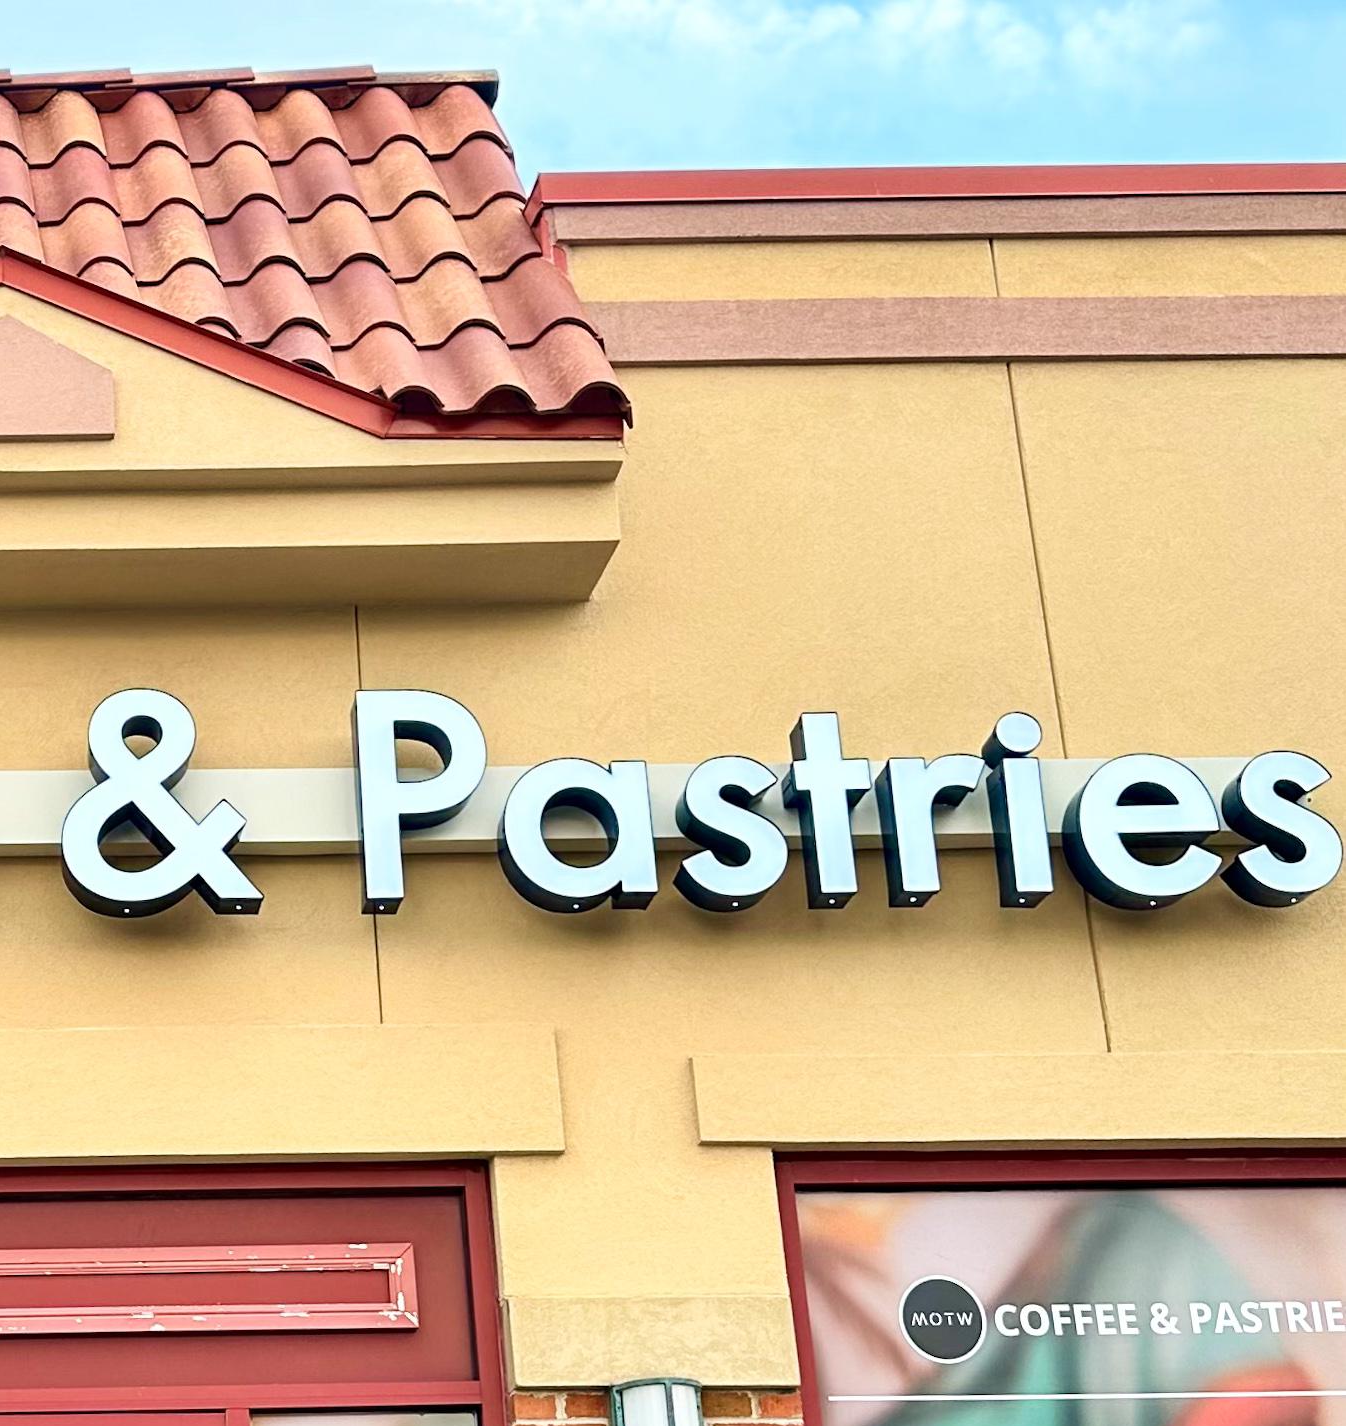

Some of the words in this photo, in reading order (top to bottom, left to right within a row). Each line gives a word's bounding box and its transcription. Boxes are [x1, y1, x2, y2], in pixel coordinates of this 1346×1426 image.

[61, 688, 263, 916] &
[353, 688, 1344, 914] Pastries
[911, 1311, 973, 1327] MOTW
[994, 1303, 1140, 1337] COFFEE
[1150, 1303, 1181, 1335] &
